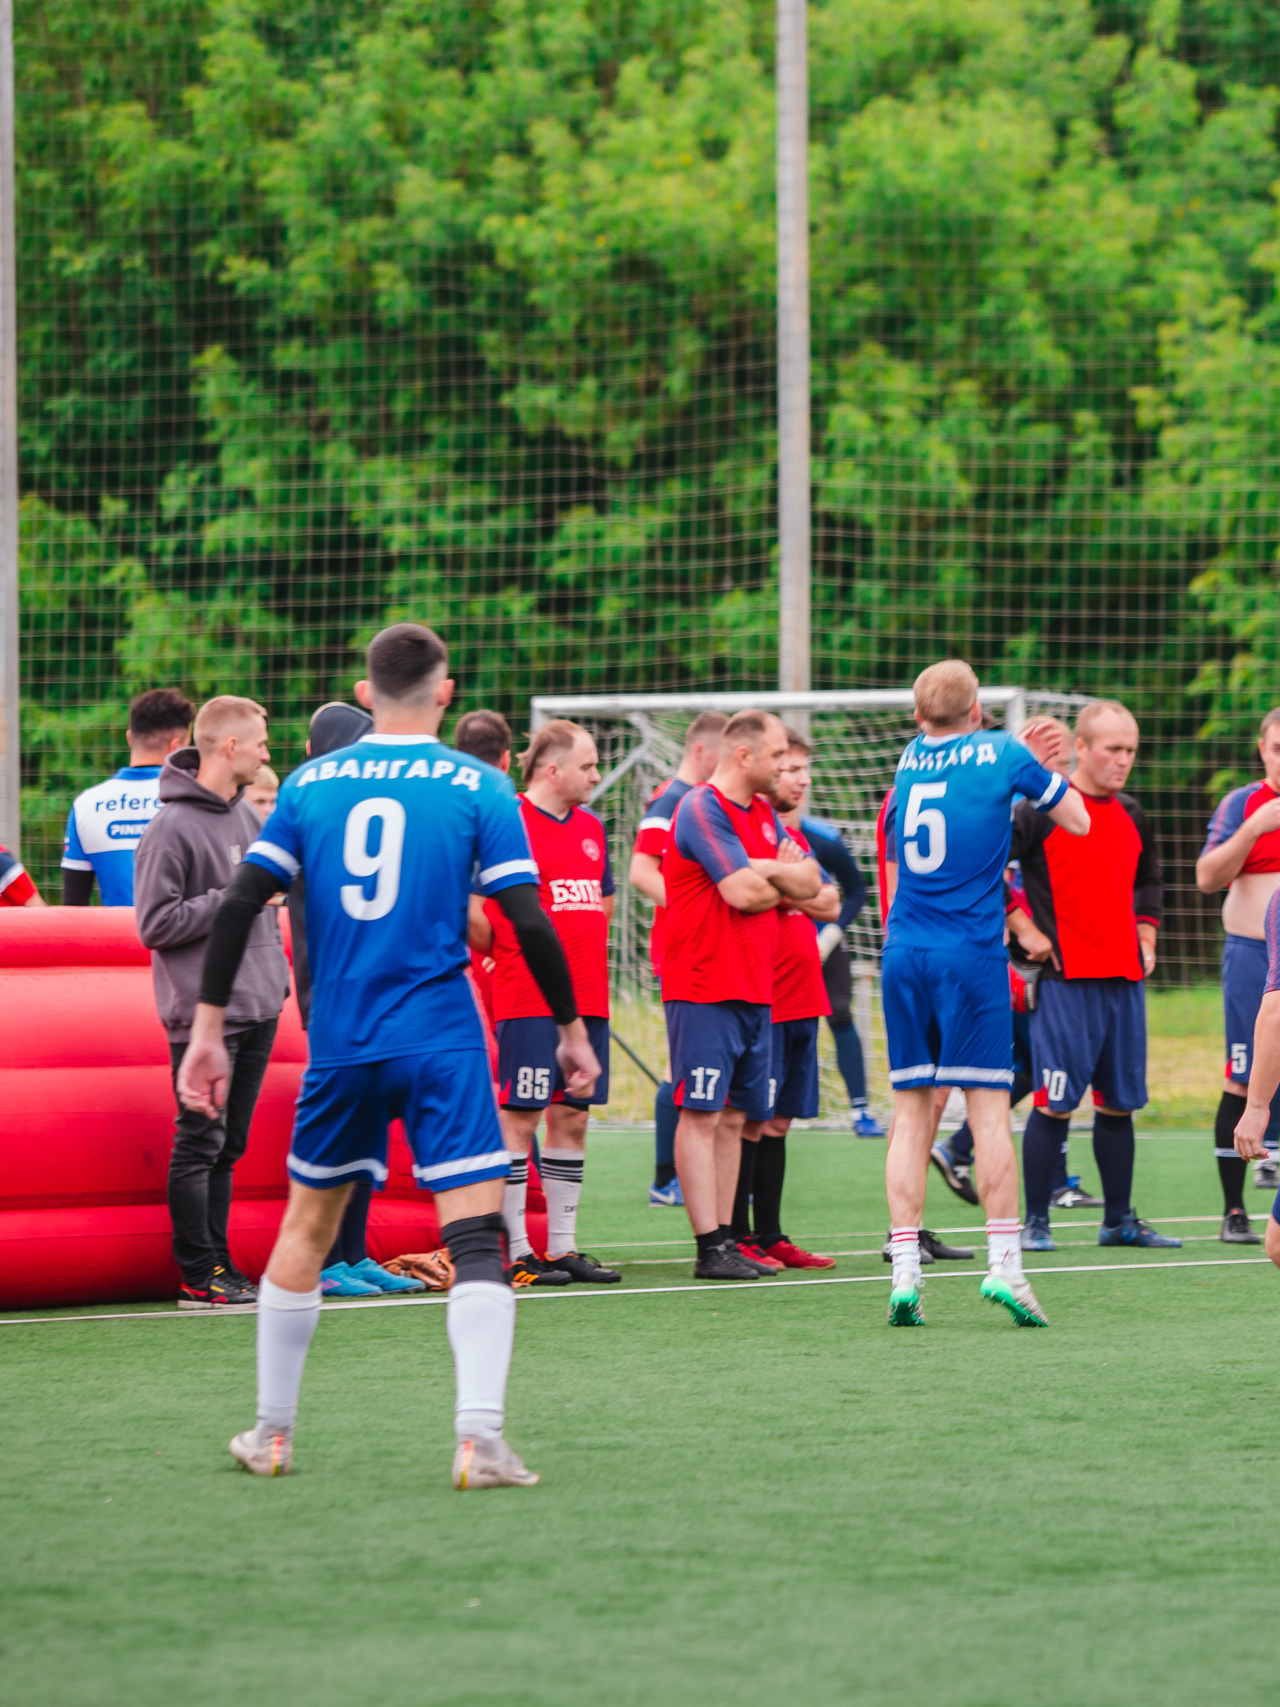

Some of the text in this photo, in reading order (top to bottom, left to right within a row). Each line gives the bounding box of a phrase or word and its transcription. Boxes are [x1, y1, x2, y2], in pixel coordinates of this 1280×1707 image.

[296, 758, 482, 791] АВАНГАРД
[95, 793, 166, 812] refere
[903, 781, 948, 875] 5
[340, 796, 407, 922] 9
[1231, 1042, 1247, 1075] 5
[516, 1066, 551, 1101] 85
[690, 1066, 721, 1101] 17
